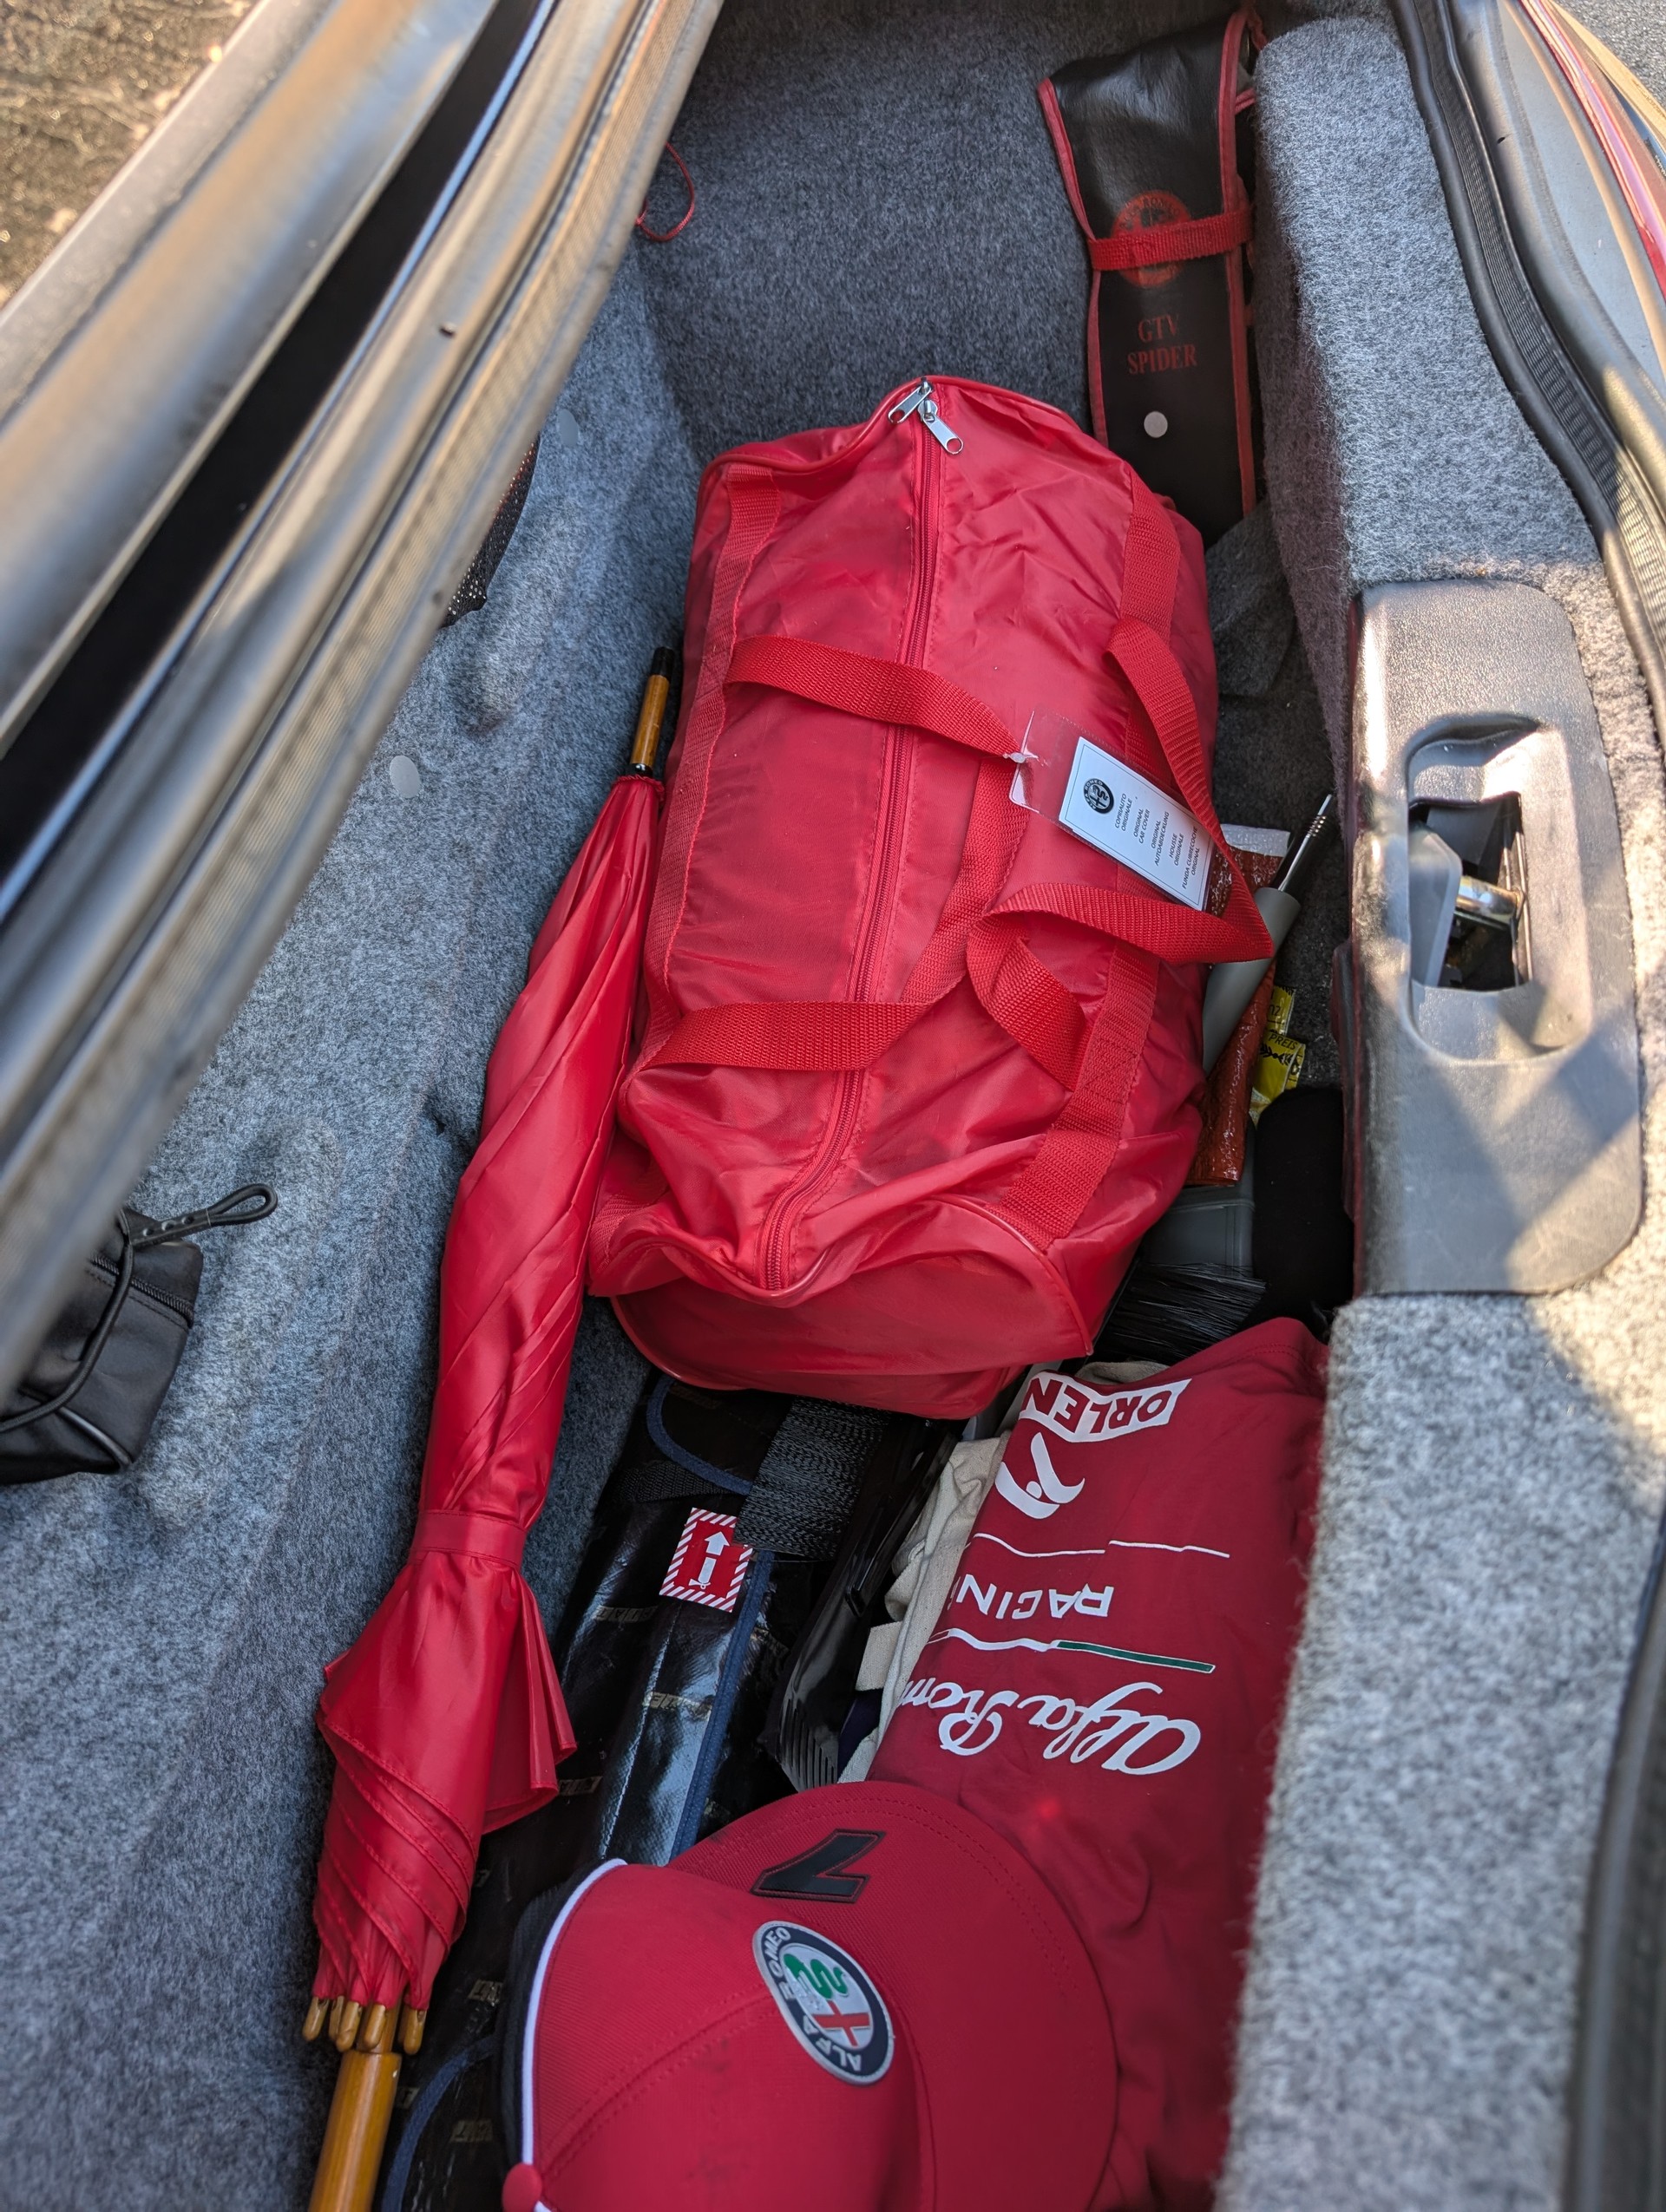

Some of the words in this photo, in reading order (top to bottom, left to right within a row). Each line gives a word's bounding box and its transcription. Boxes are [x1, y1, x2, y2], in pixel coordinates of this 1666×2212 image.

[1138, 313, 1179, 344] GTV
[1127, 344, 1197, 376] SPIDER
[1115, 793, 1127, 828] COPRIAUTO
[1121, 798, 1132, 831] ORIGINALE
[1133, 808, 1144, 837] ORIGINAL
[1151, 821, 1161, 849] ORIGINAL
[1154, 811, 1170, 867] AUTOABDECKUNG
[1169, 834, 1177, 859] HOUSSE
[1173, 834, 1184, 866] ORIGINALE
[1186, 826, 1197, 867] CUBRECOCHE
[1190, 847, 1200, 876] ORIGINAL
[1269, 1033, 1298, 1050] PREIS
[1022, 1378, 1172, 1434] ORLEN
[948, 1574, 1114, 1620] RACIN
[1017, 1681, 1201, 1775] Alfa
[751, 1829, 885, 1903] 7
[764, 1927, 797, 2000] ROMEO
[803, 2014, 862, 2071] ALFA
